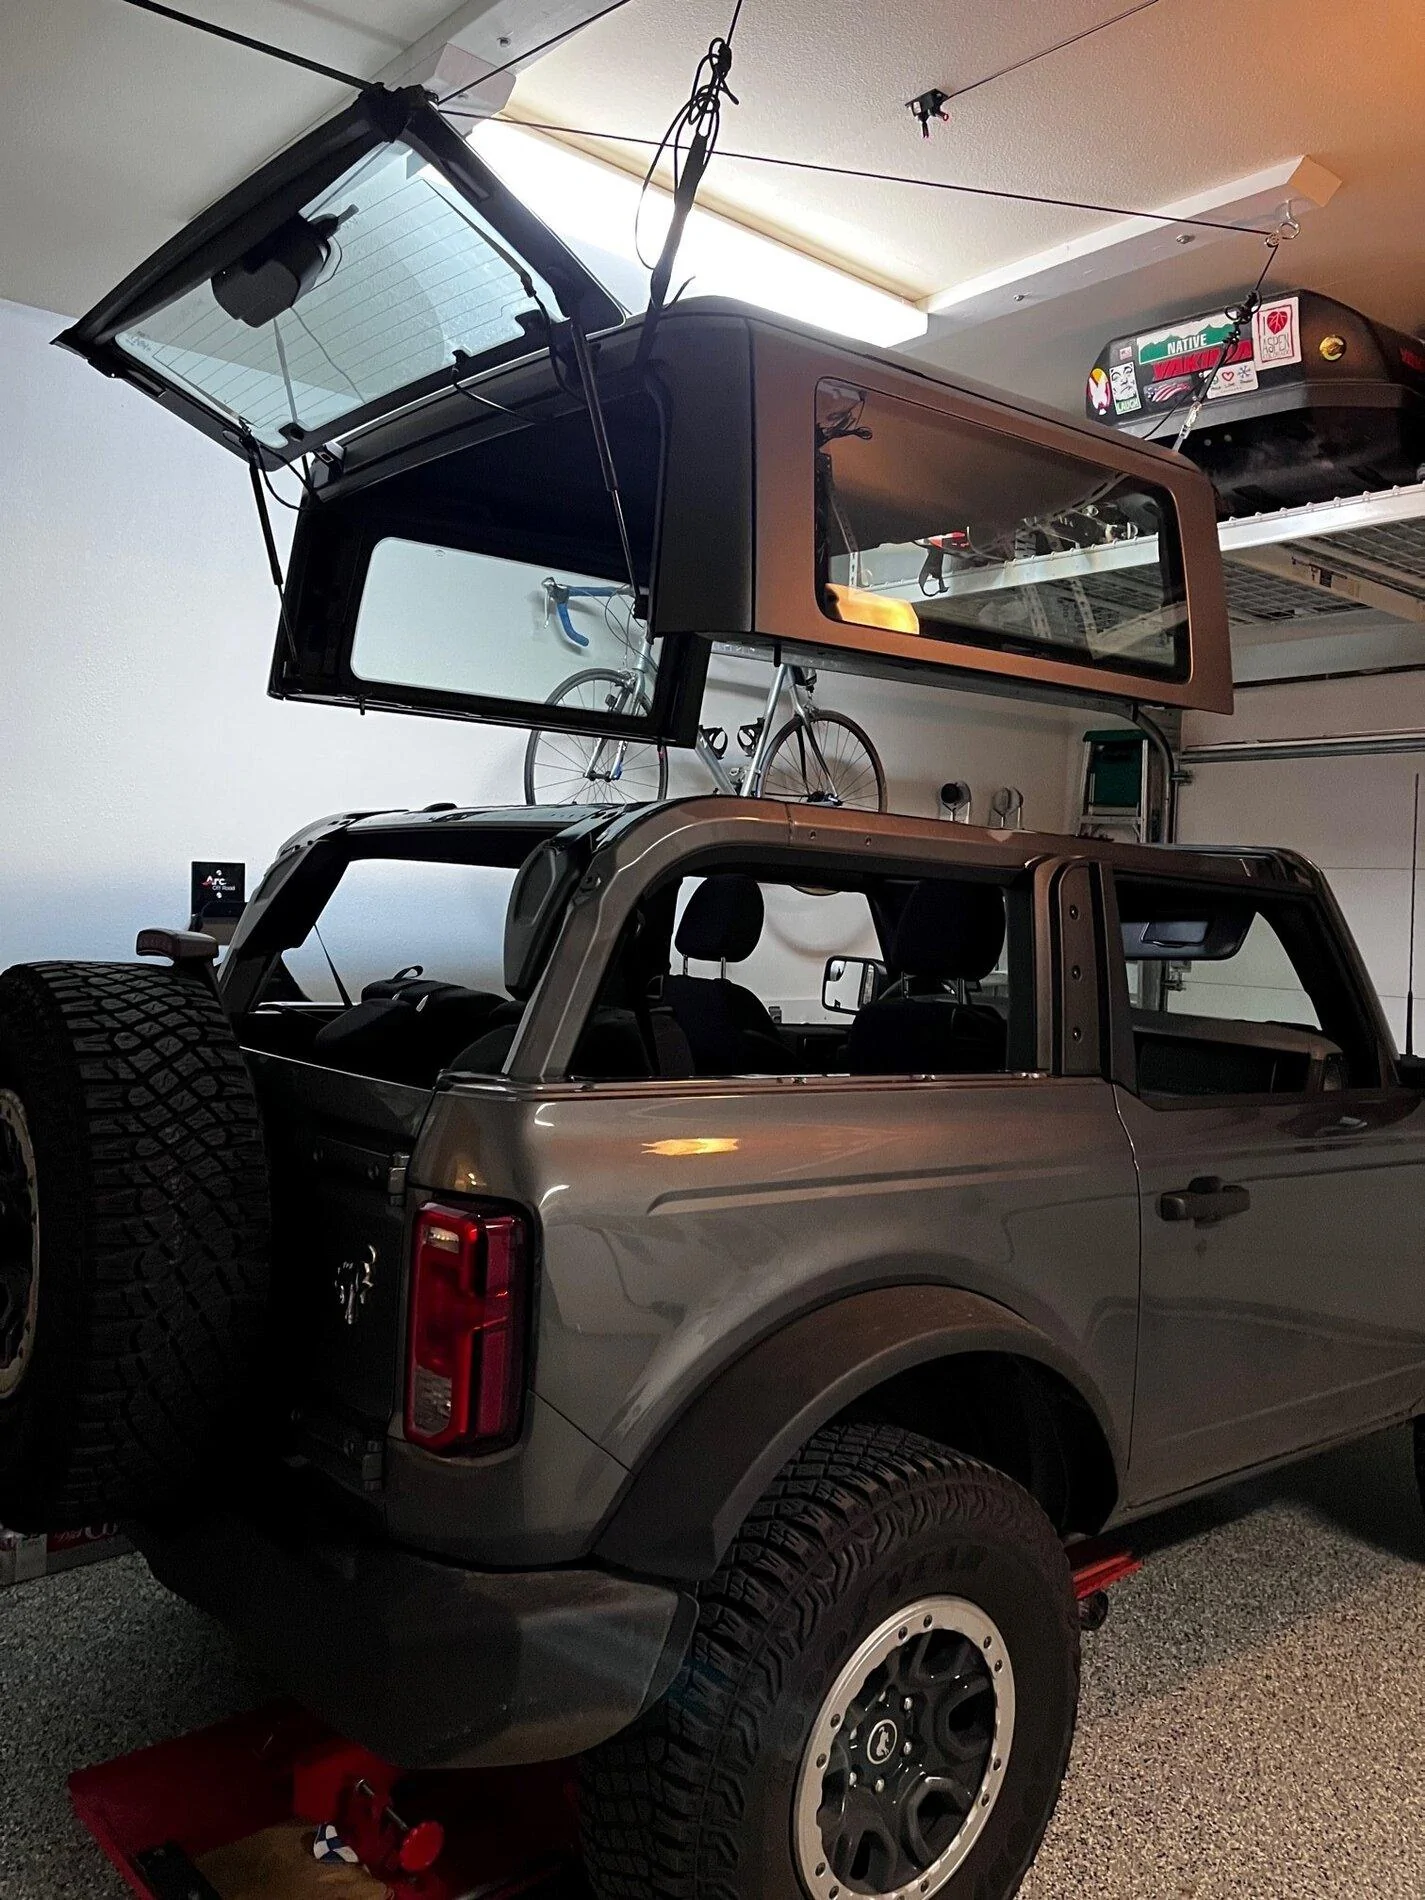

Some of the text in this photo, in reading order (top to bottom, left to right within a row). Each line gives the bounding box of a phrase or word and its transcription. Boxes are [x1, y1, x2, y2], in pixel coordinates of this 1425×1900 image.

[1262, 316, 1266, 335] I
[1167, 333, 1208, 354] NATIVE
[1262, 333, 1290, 353] ASPEN
[202, 875, 227, 886] Arc
